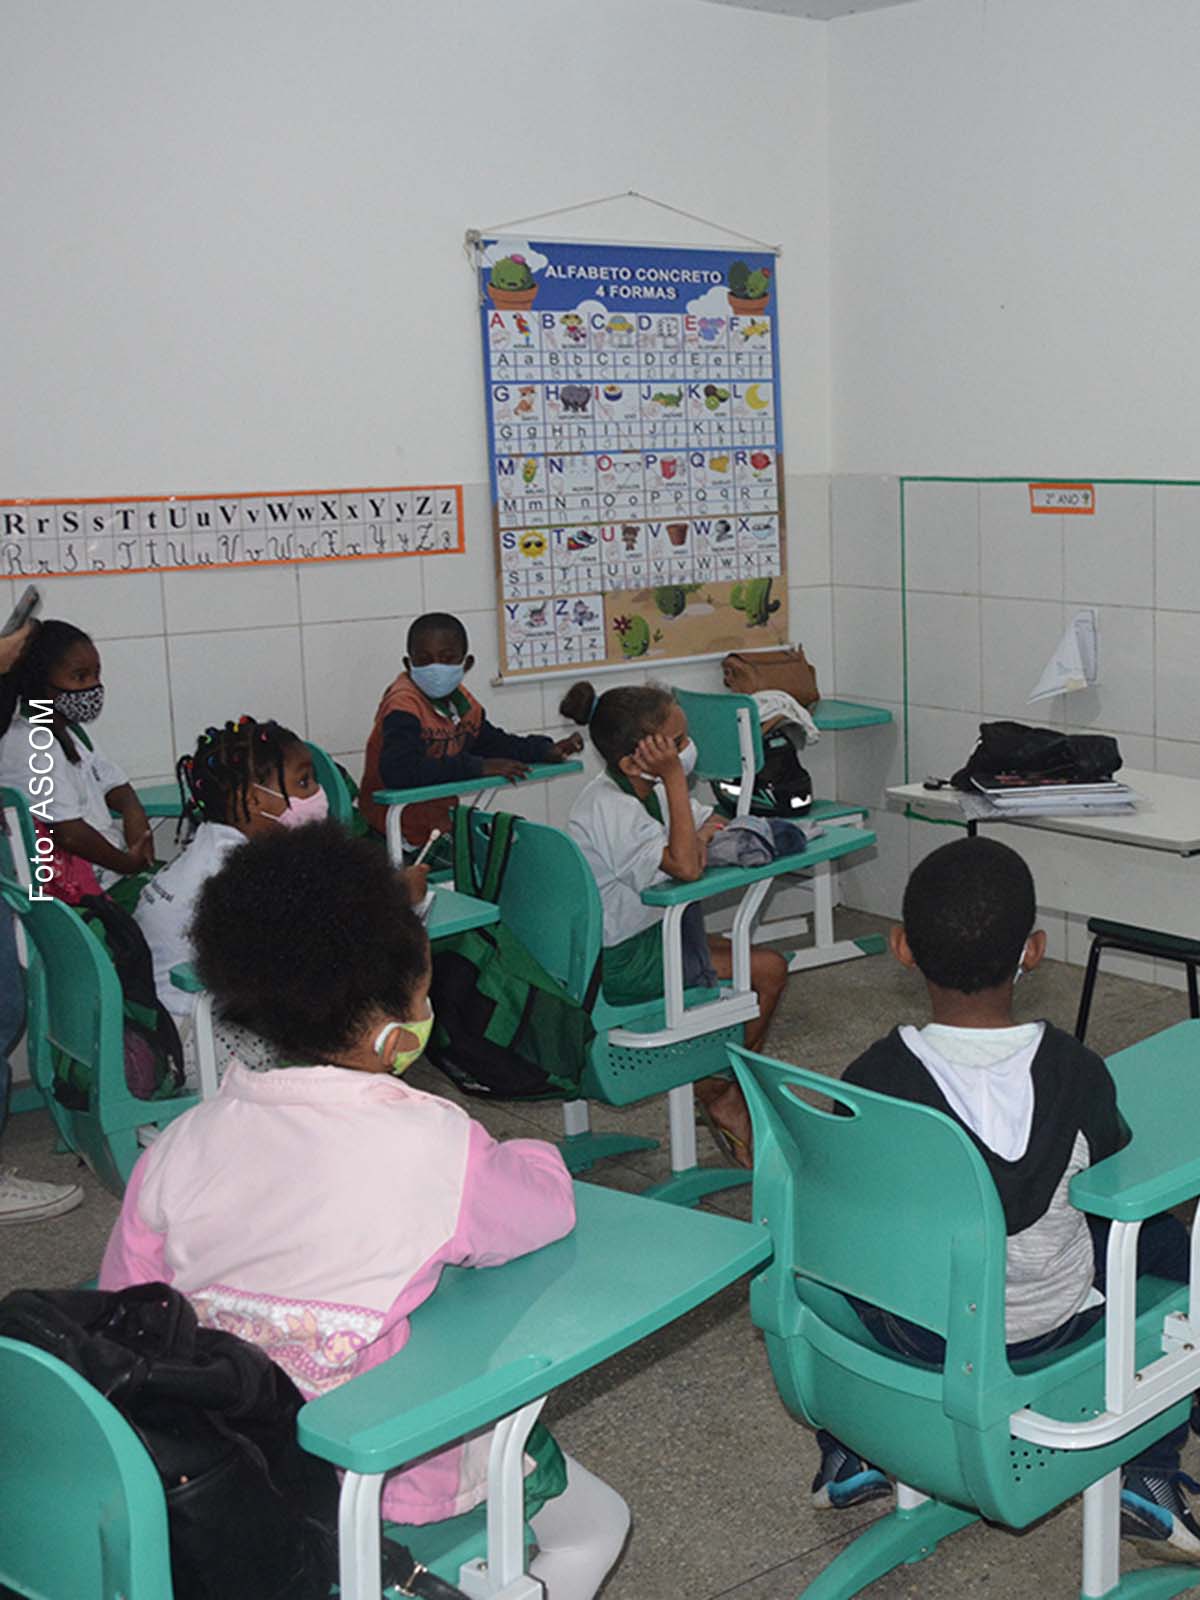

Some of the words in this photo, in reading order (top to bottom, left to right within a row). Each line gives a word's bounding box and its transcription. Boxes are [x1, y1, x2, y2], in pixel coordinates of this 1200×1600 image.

[545, 265, 631, 281] ALFABETO
[636, 267, 722, 284] CONCRETO
[595, 286, 605, 298] 4
[610, 285, 676, 300] FORMAS
[490, 312, 505, 328] A
[542, 314, 555, 329] B
[591, 314, 605, 329] C
[639, 316, 651, 331] D
[685, 316, 696, 331] E
[730, 318, 739, 331] F
[498, 354, 509, 365] A
[524, 355, 533, 365] a
[550, 352, 559, 365] B
[574, 354, 582, 365] b
[597, 352, 608, 365] C
[623, 356, 630, 365] c
[645, 354, 655, 365] D
[669, 354, 677, 365] d
[691, 353, 700, 365] E
[714, 357, 722, 366] e
[736, 353, 743, 365] F
[494, 386, 509, 401] G
[546, 386, 559, 400] H
[595, 386, 599, 400] I
[642, 386, 651, 400] J
[688, 385, 700, 398] K
[733, 385, 741, 398] L
[498, 460, 514, 475] M
[550, 459, 563, 473] N
[597, 455, 612, 471] O
[646, 455, 657, 469] P
[691, 453, 705, 468] Q
[735, 451, 748, 465] R
[504, 500, 516, 512] M
[529, 501, 542, 509] m
[556, 497, 566, 508] N
[581, 499, 589, 507] n
[603, 494, 615, 507] O
[629, 496, 637, 506] o
[652, 491, 659, 501] P
[674, 491, 682, 502] p
[696, 489, 707, 500] Q
[721, 489, 728, 498] q
[741, 488, 750, 498] R
[4, 513, 25, 535] R
[38, 518, 50, 533] r
[63, 511, 79, 533] S
[93, 516, 104, 532] s
[116, 510, 135, 530] T
[148, 512, 156, 528] t
[169, 508, 187, 528] U
[197, 512, 210, 526] u
[220, 505, 237, 524] V
[247, 510, 260, 523] v
[267, 503, 293, 521] W
[297, 507, 314, 520] w
[321, 501, 337, 520] X
[348, 505, 358, 519] x
[369, 498, 385, 517] Y
[396, 502, 407, 522] y
[417, 497, 432, 515] Z
[441, 501, 452, 514] z
[503, 533, 516, 549] S
[553, 529, 564, 544] T
[602, 527, 615, 542] U
[649, 524, 661, 538] V
[694, 521, 711, 535] W
[739, 518, 750, 532] X
[505, 604, 519, 619] Y
[556, 600, 568, 615] Z
[513, 643, 524, 655] Y
[541, 642, 547, 651] y
[564, 638, 573, 650] Z
[589, 638, 596, 648] z
